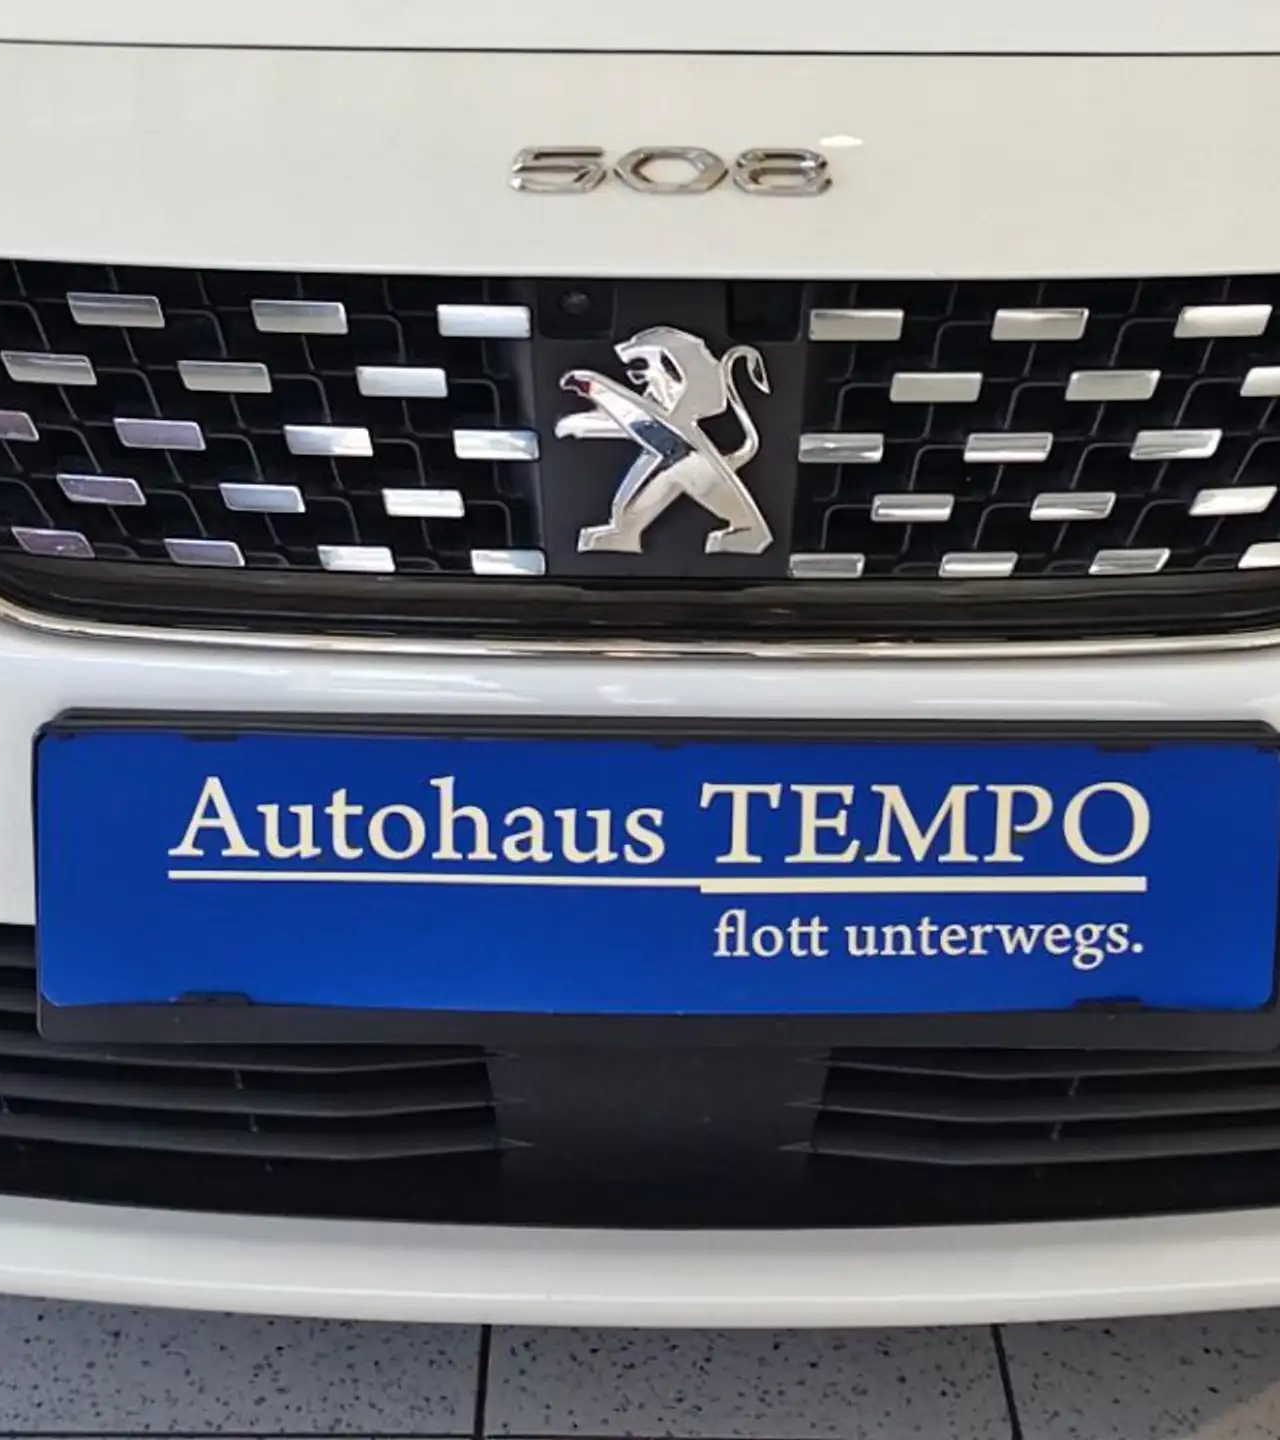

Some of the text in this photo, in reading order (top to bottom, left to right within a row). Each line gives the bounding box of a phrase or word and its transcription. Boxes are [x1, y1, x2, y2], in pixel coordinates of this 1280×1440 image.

[510, 146, 833, 198] 508
[167, 775, 1151, 864] Autohaus TEMPO
[713, 908, 1144, 970] flott unterwegs.
